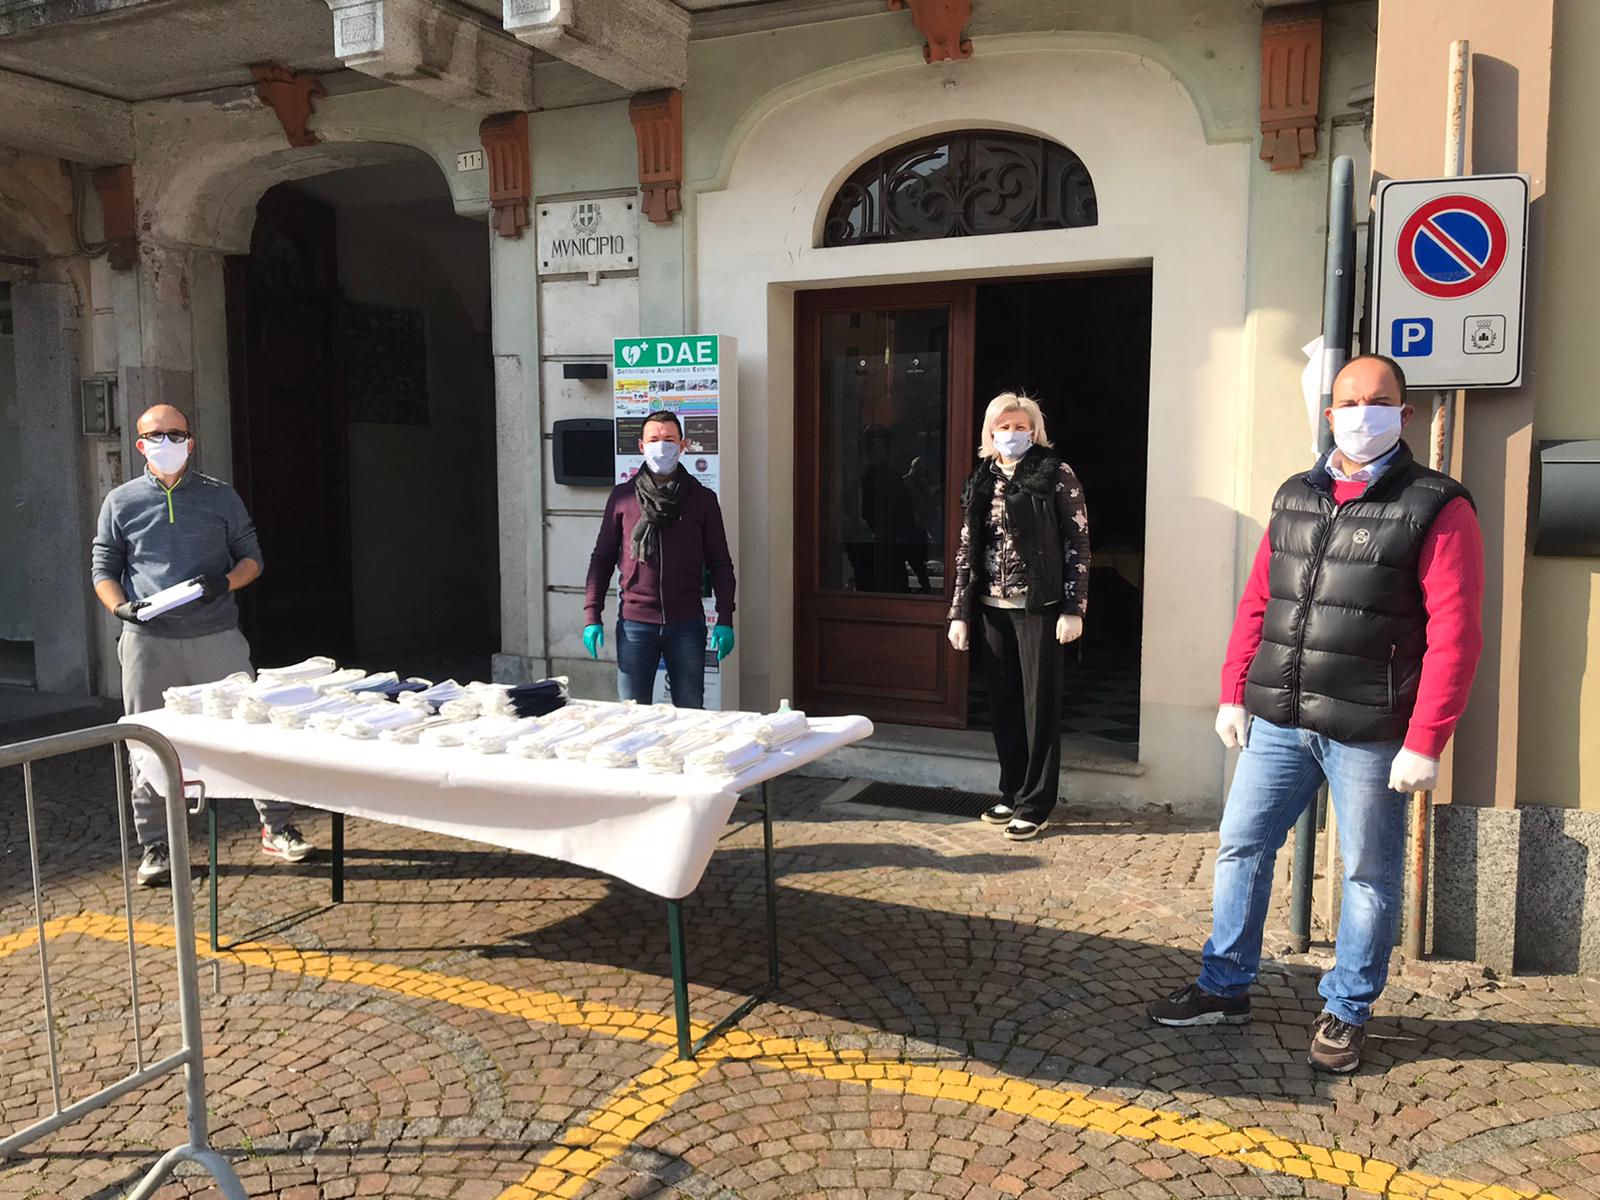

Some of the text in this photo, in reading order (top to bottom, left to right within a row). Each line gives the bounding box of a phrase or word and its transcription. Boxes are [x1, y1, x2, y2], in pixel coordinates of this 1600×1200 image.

[463, 154, 475, 168] 11
[551, 235, 624, 258] MVNICIPIO
[1401, 323, 1426, 353] P
[656, 341, 713, 365] DAE
[657, 366, 691, 374] Automatico
[692, 365, 717, 373] Esterno
